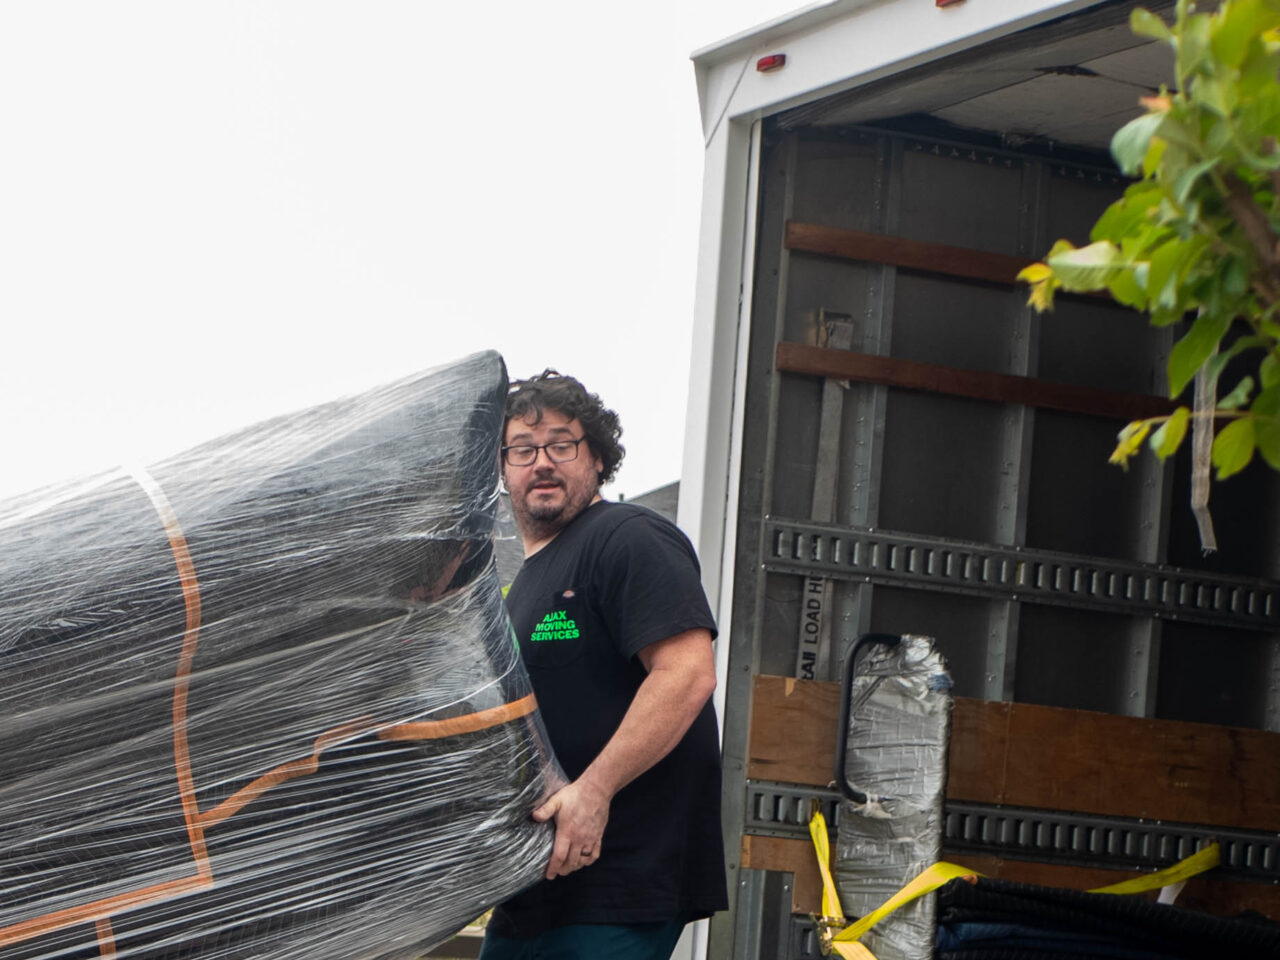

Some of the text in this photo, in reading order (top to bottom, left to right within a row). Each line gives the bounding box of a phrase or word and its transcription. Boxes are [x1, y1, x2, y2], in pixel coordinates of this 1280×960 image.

[543, 610, 567, 622] AJAX
[804, 599, 822, 645] LOAD
[535, 620, 576, 631] MOVING
[530, 629, 580, 641] SERVICES
